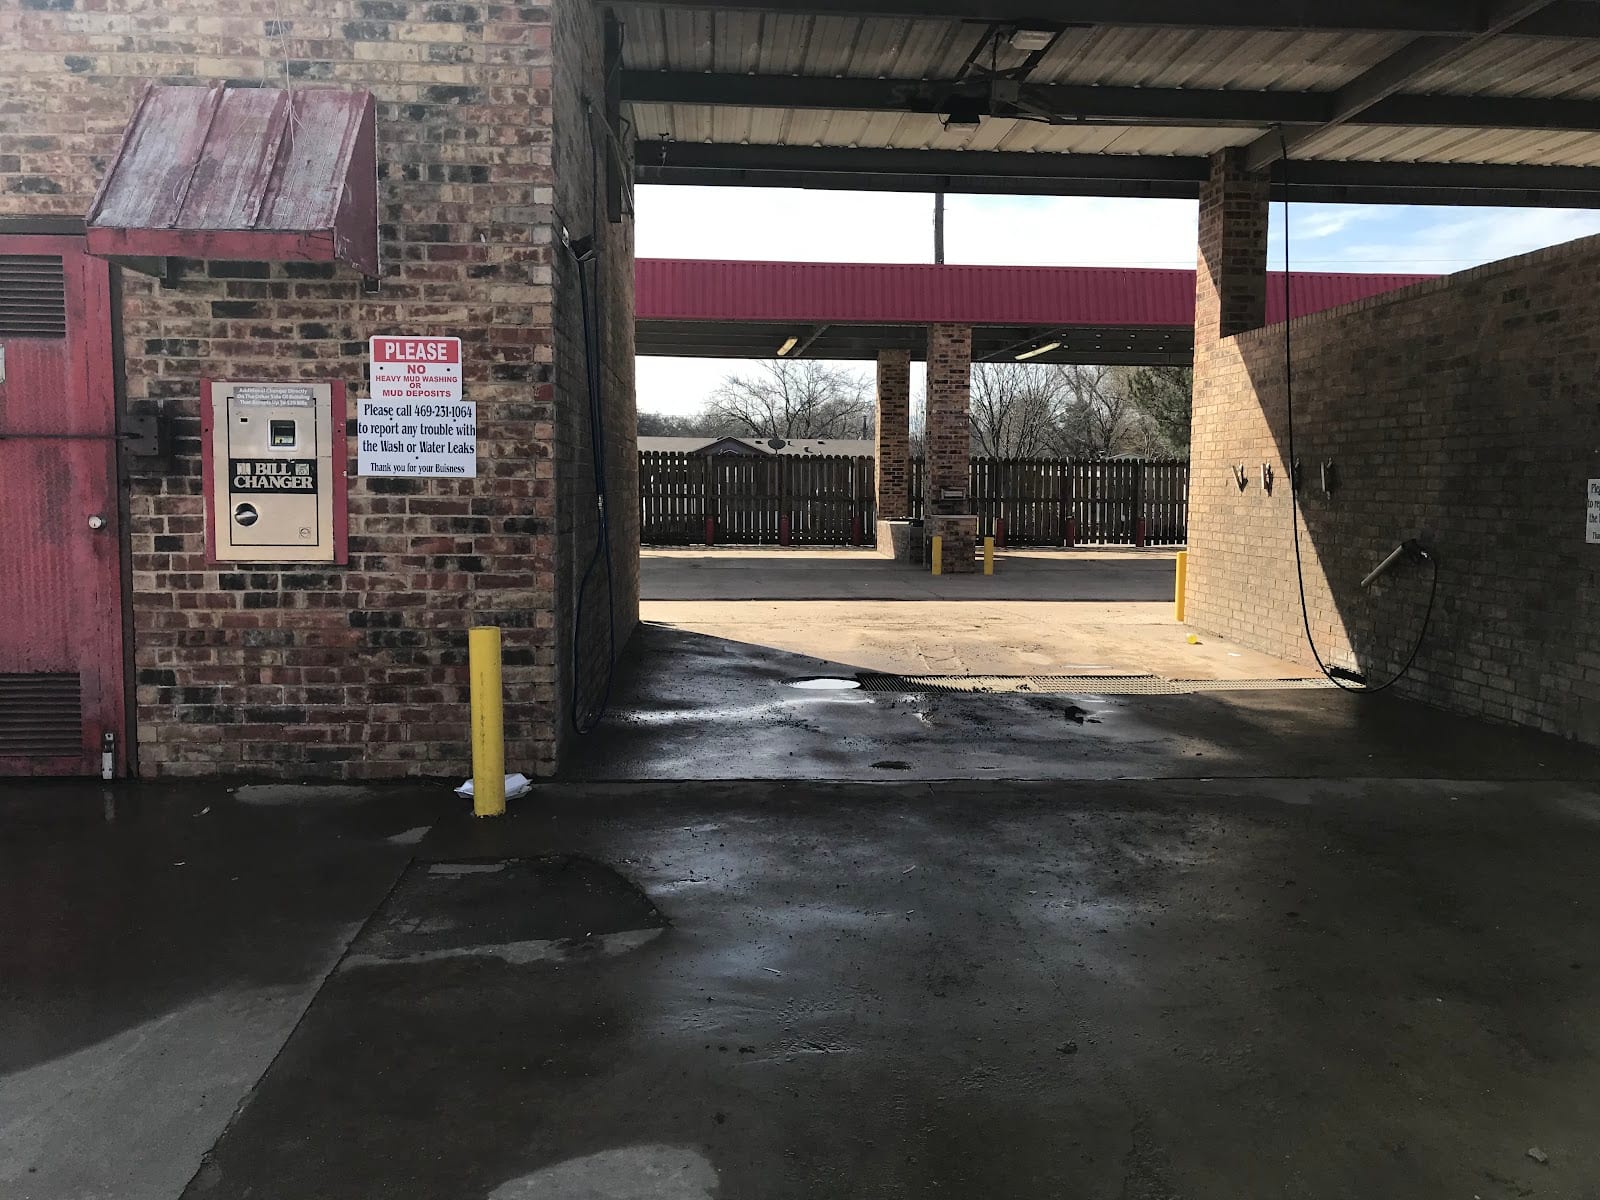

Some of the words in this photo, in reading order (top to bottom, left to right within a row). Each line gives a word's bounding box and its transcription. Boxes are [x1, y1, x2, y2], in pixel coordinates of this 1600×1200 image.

[385, 342, 447, 361] PLEASE
[407, 365, 426, 374] NO
[364, 404, 394, 416] Please
[396, 405, 412, 416] call
[358, 422, 368, 434] to
[370, 423, 399, 437] report
[402, 425, 417, 438] any
[420, 423, 454, 436] trouble
[456, 424, 476, 436] with
[362, 440, 378, 452] the
[380, 440, 404, 453] Wash
[406, 443, 417, 453] or
[420, 441, 445, 453] Water
[447, 442, 475, 454] Leaks
[255, 462, 291, 475] BILL
[370, 462, 391, 472] Thank
[393, 465, 405, 474] you
[407, 463, 416, 472] for
[418, 465, 433, 474] your
[435, 464, 465, 473] Buisness
[234, 476, 313, 488] CHANGER
